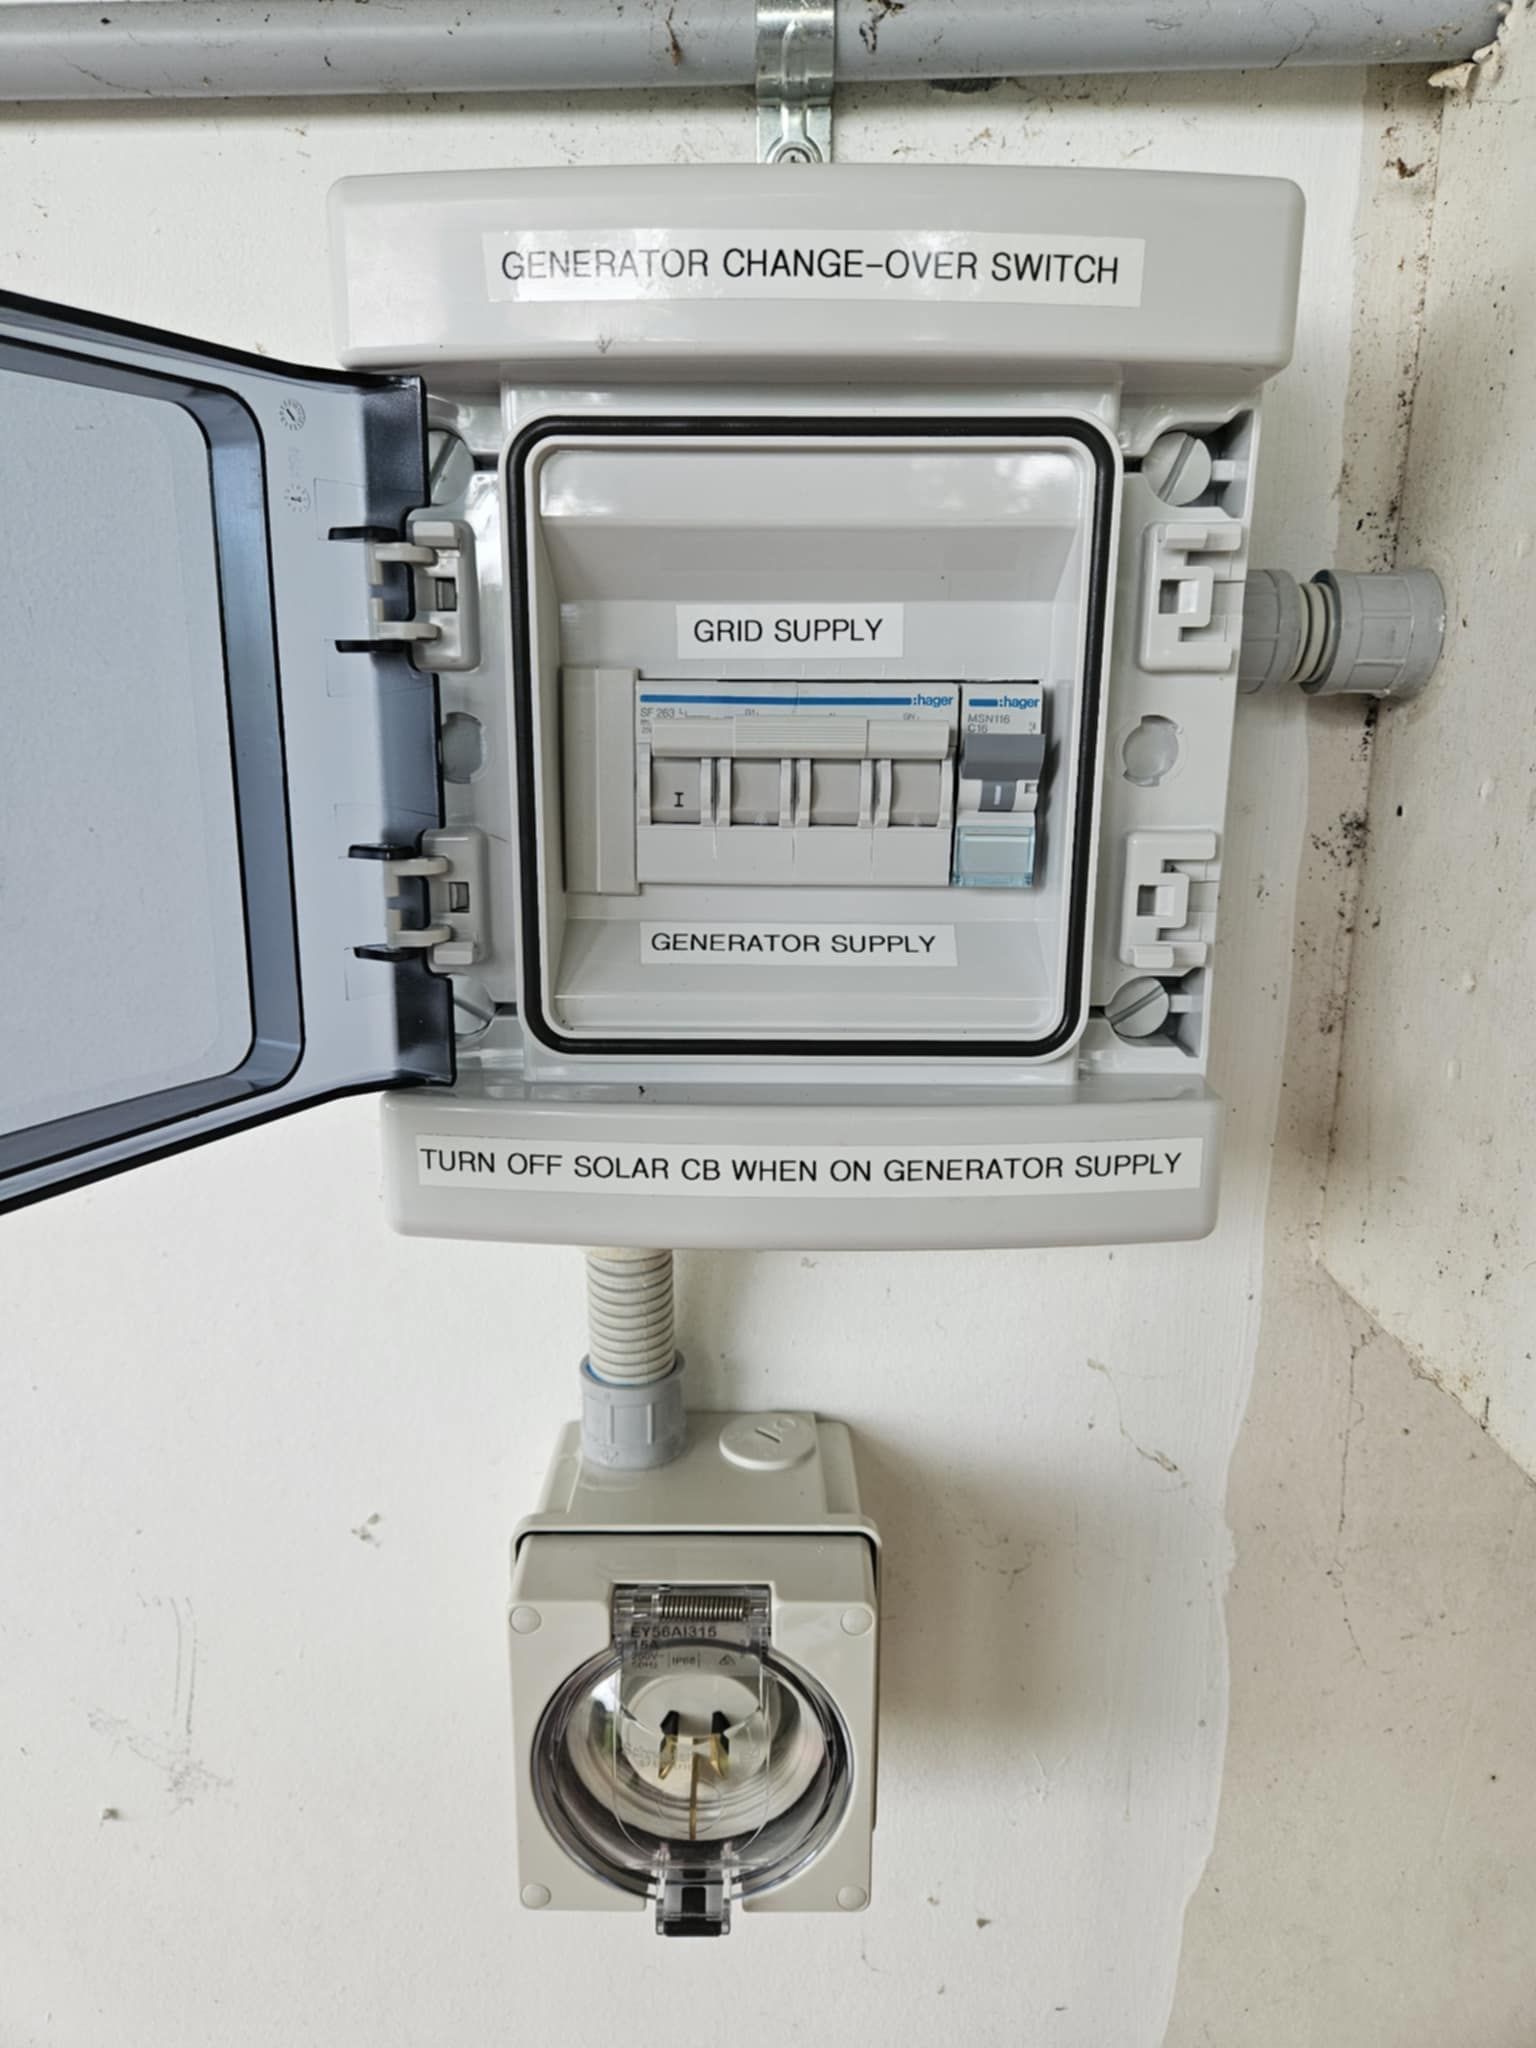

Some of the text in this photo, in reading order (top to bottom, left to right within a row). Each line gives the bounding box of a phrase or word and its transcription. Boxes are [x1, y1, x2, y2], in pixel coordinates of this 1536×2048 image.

[501, 247, 1119, 285] GENERATOR CHANGE-OVER SWITCH
[694, 618, 884, 643] GRID SUPPLY
[650, 932, 936, 953] GENERATOR SUPPLY
[420, 1147, 1182, 1183] TURN OFF SOLAR CB WHEN ON GENERATOR SUPPLY
